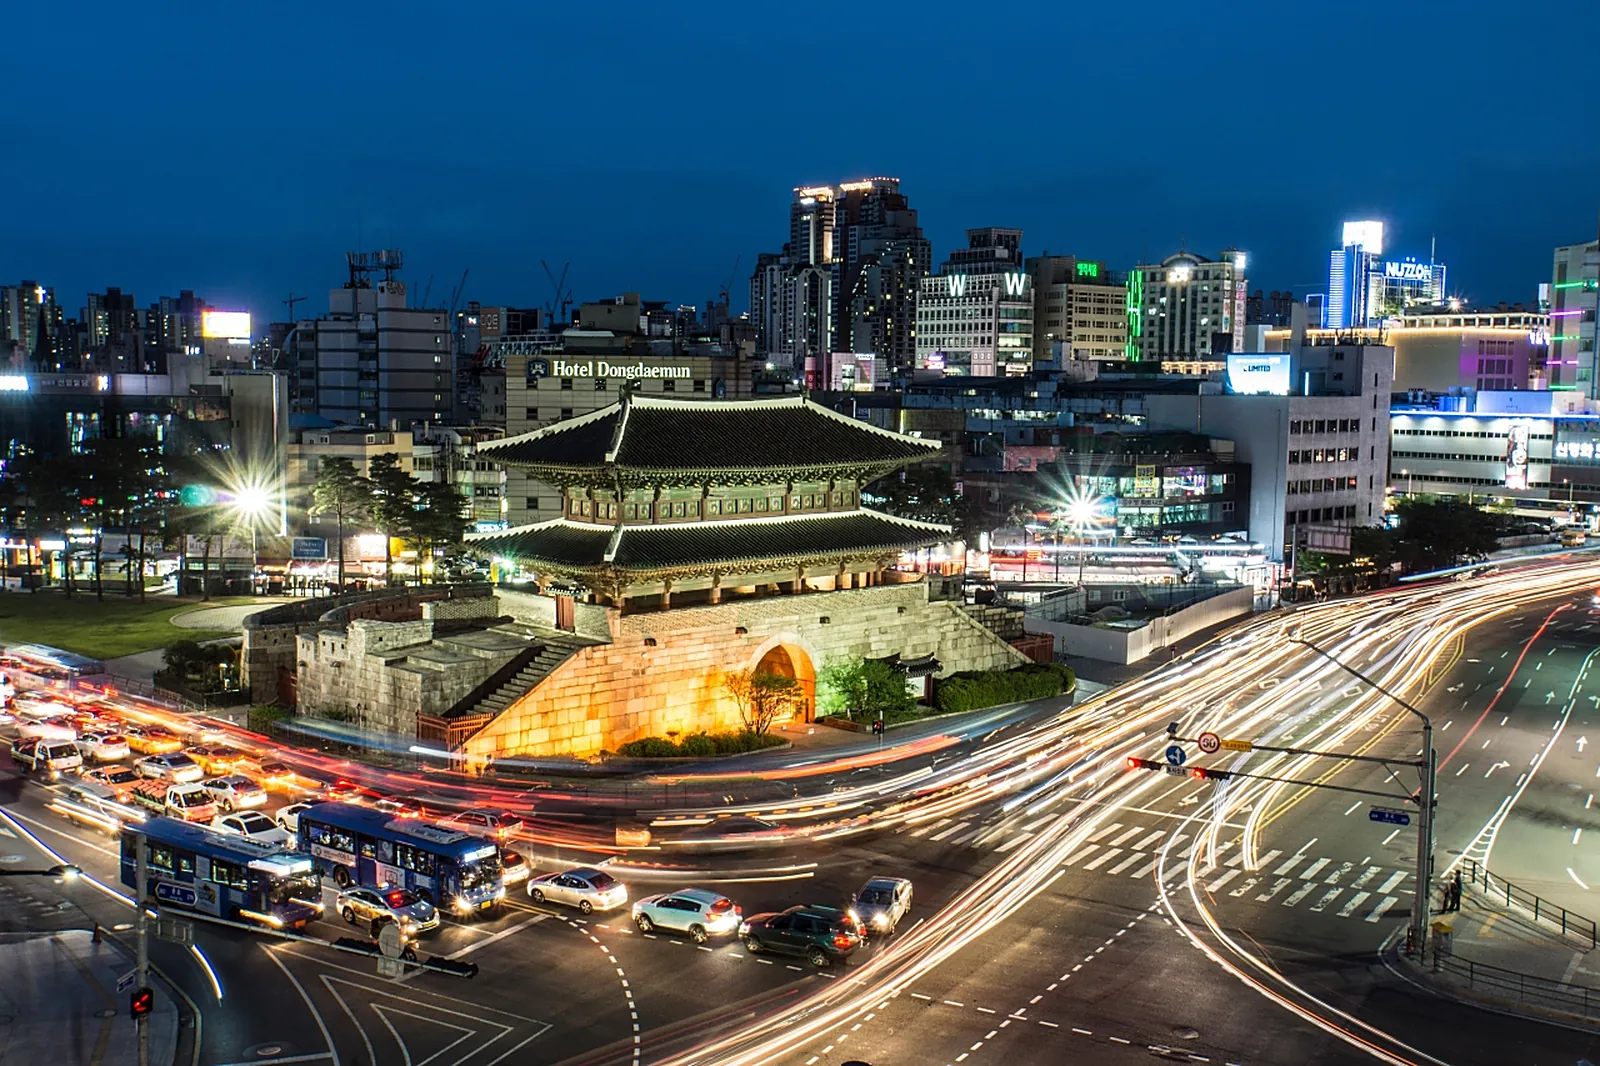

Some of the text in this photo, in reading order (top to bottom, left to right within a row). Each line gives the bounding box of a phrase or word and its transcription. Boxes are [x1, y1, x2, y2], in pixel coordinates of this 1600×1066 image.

[947, 274, 966, 297] W
[1004, 272, 1026, 296] W
[552, 360, 691, 379] Hotel Dongdaemun
